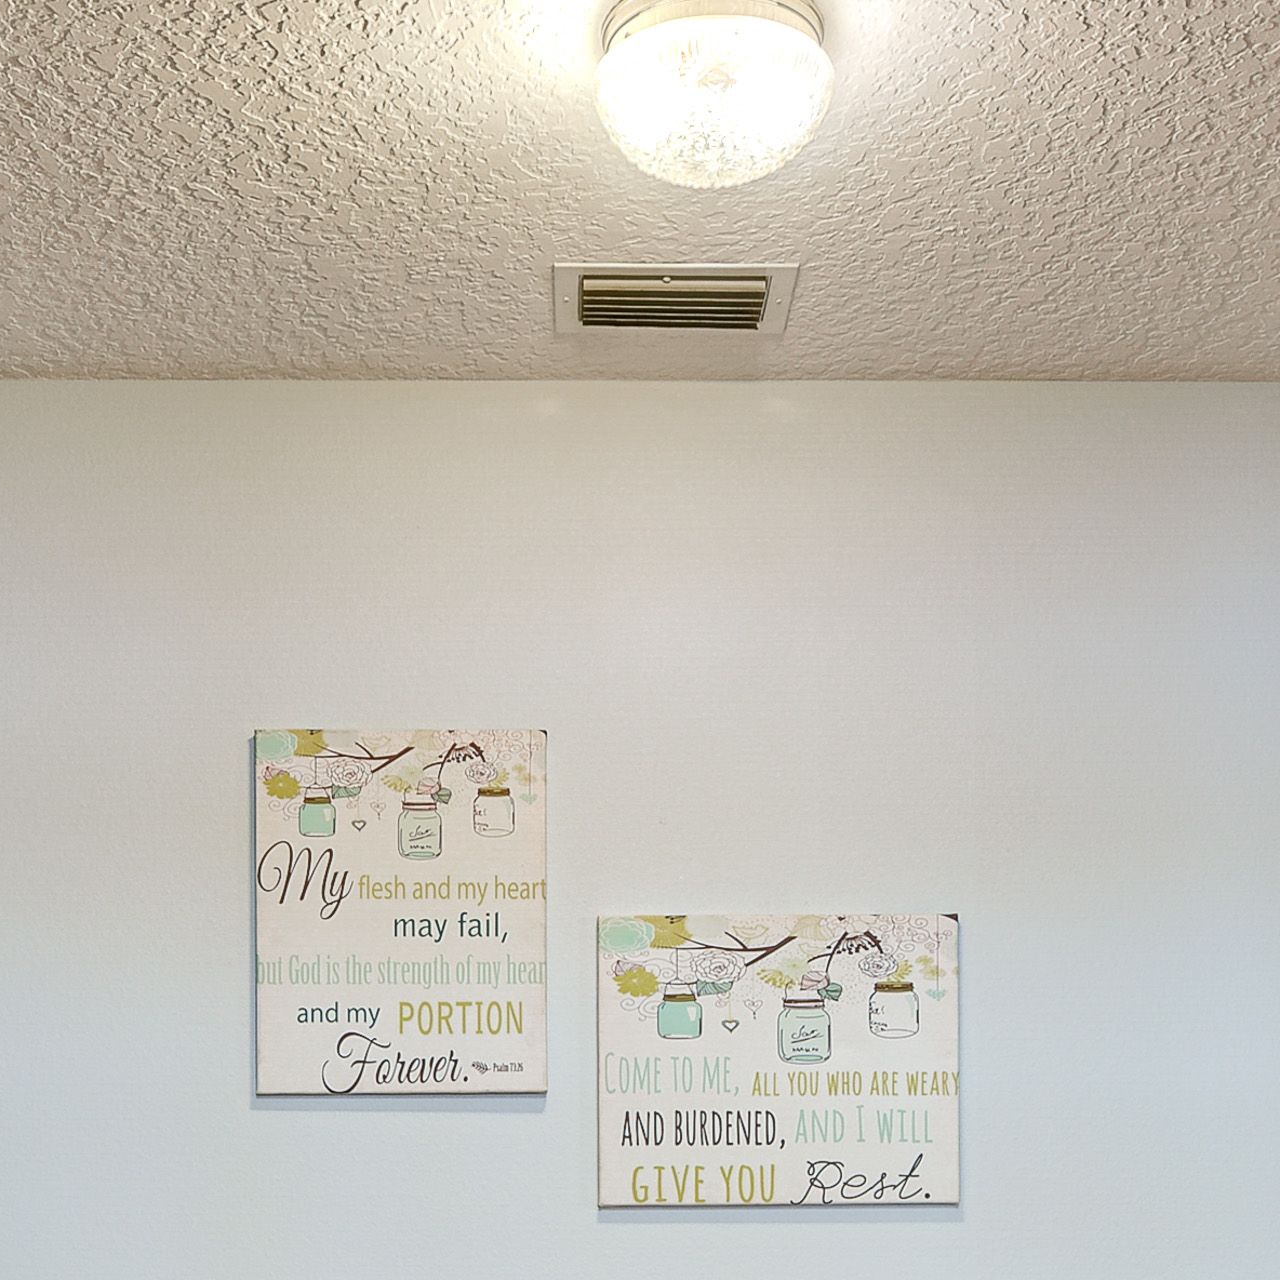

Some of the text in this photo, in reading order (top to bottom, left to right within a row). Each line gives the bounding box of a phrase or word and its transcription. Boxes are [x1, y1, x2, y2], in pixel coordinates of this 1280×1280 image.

[257, 840, 547, 920] My flesh and my heart
[394, 912, 508, 943] may fail,
[289, 954, 320, 985] God
[326, 954, 340, 985] is
[346, 954, 372, 985] the
[378, 954, 450, 990] strength
[455, 954, 474, 985] of
[476, 961, 501, 990] my
[297, 1001, 524, 1035] and my PORTION
[321, 1031, 469, 1094] Forever.
[604, 1052, 960, 1097] COME TO ME, ALL YOU WHO ARE WEARY
[621, 1105, 933, 1150] AND BURDENED, AND I WILL
[631, 1153, 932, 1206] GIVE YOU Rest.
